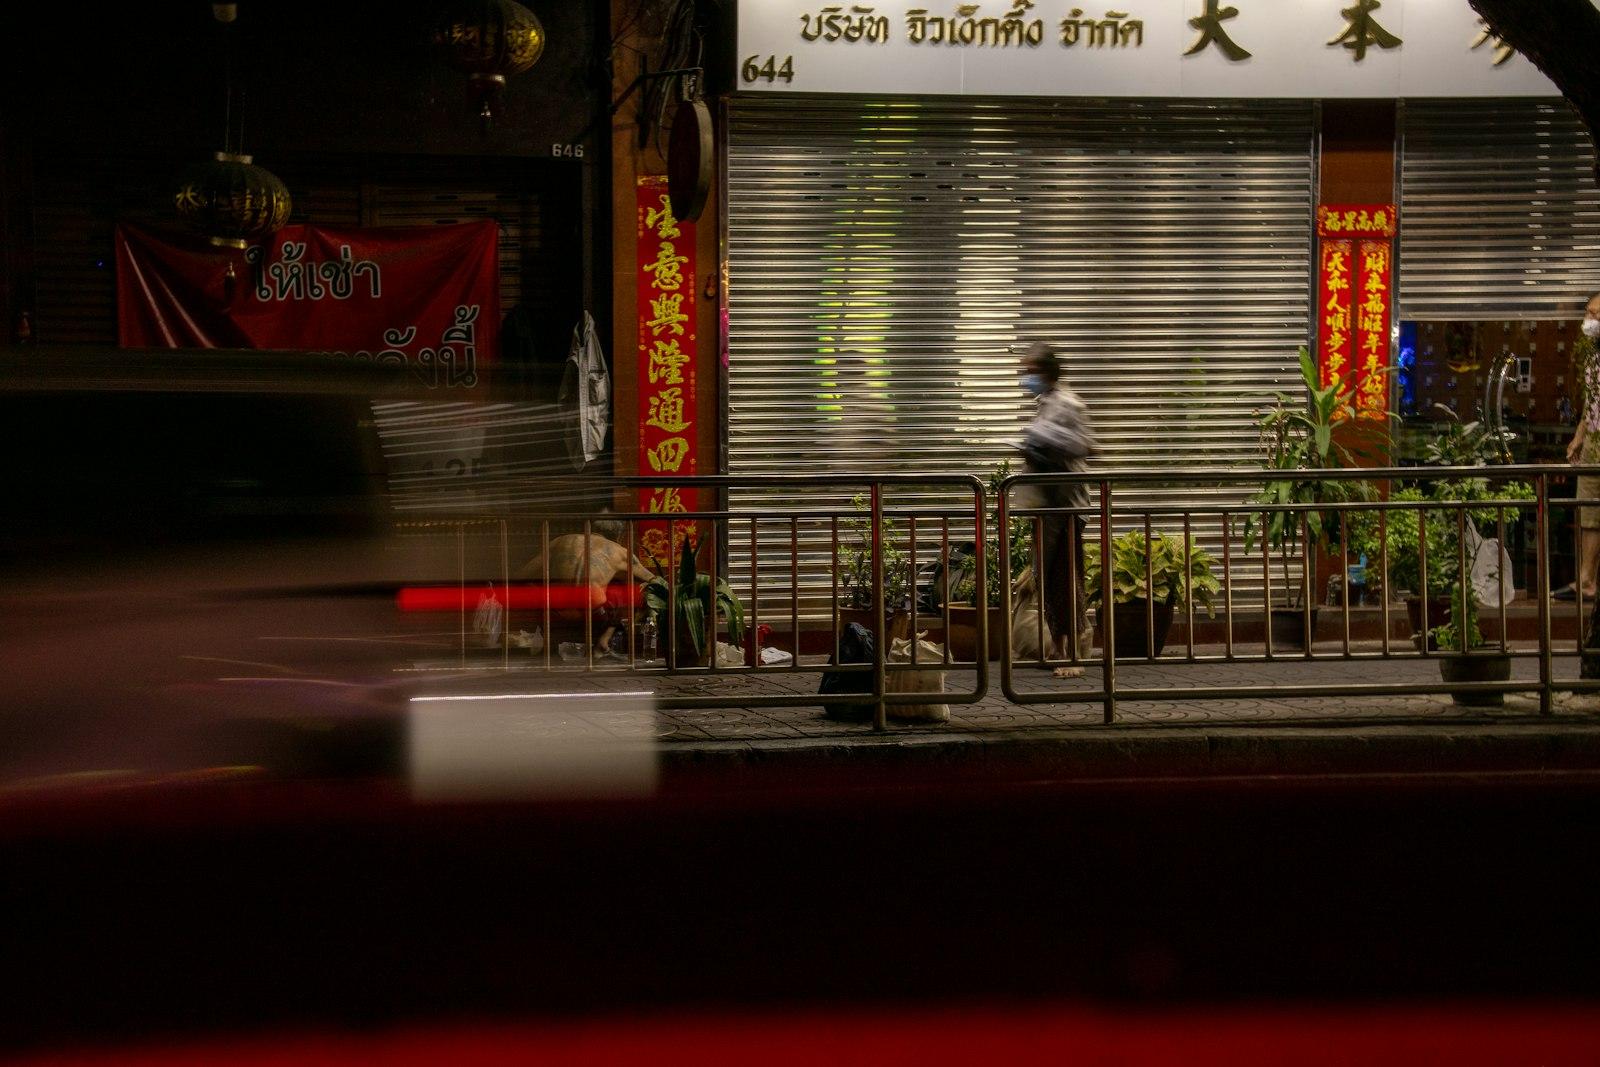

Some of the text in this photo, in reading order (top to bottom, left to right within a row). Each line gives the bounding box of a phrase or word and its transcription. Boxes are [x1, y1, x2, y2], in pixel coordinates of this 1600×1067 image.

[799, 5, 889, 43] บริษัท
[1059, 8, 1143, 47] จำกัด
[742, 54, 795, 83] 644
[552, 143, 584, 157] 646
[246, 241, 383, 301] ให้เช่า
